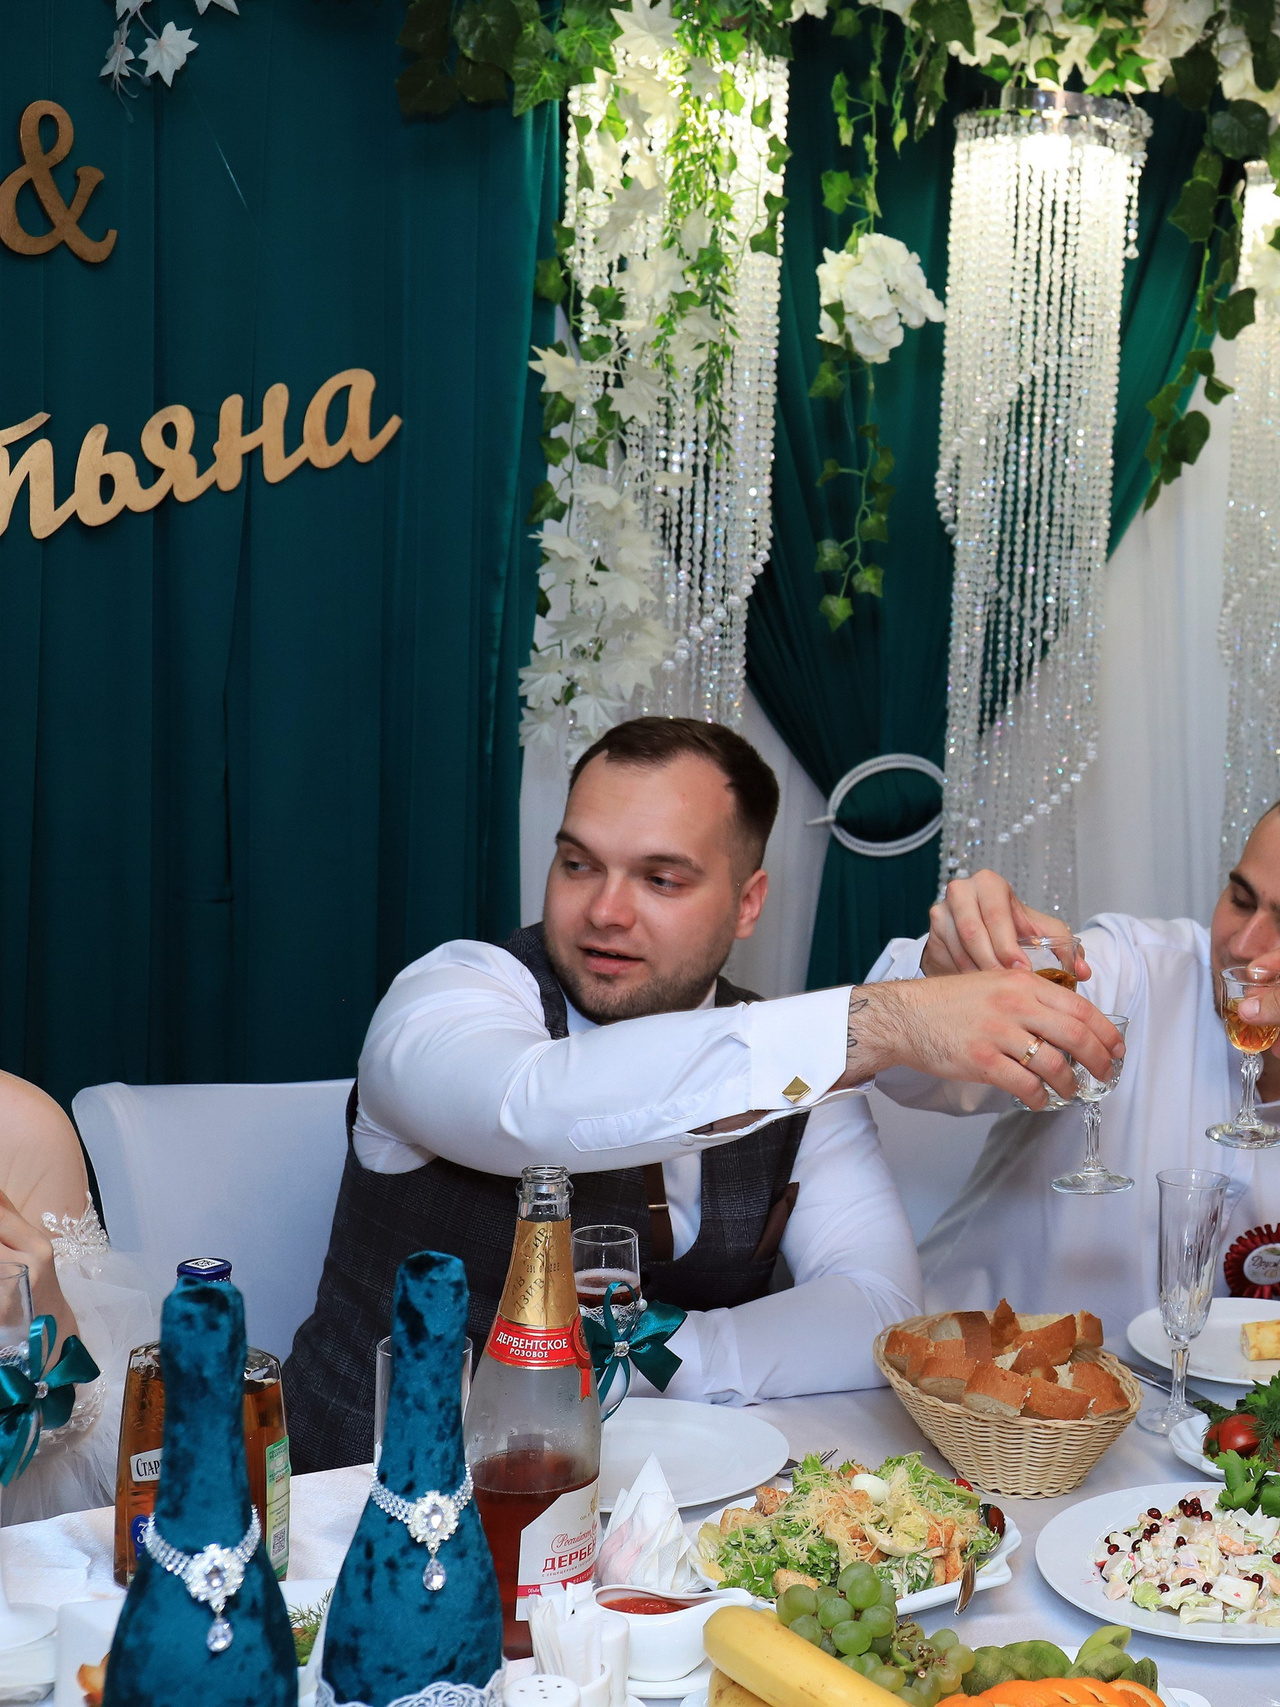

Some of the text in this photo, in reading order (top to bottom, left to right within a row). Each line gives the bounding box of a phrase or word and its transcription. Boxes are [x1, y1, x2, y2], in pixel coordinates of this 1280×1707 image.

[0, 100, 118, 263] &
[496, 1331, 568, 1351] ДЕРБЕНТСКОЕ
[509, 1347, 548, 1358] РОЗОВОЕ
[136, 1458, 161, 1477] СТАР
